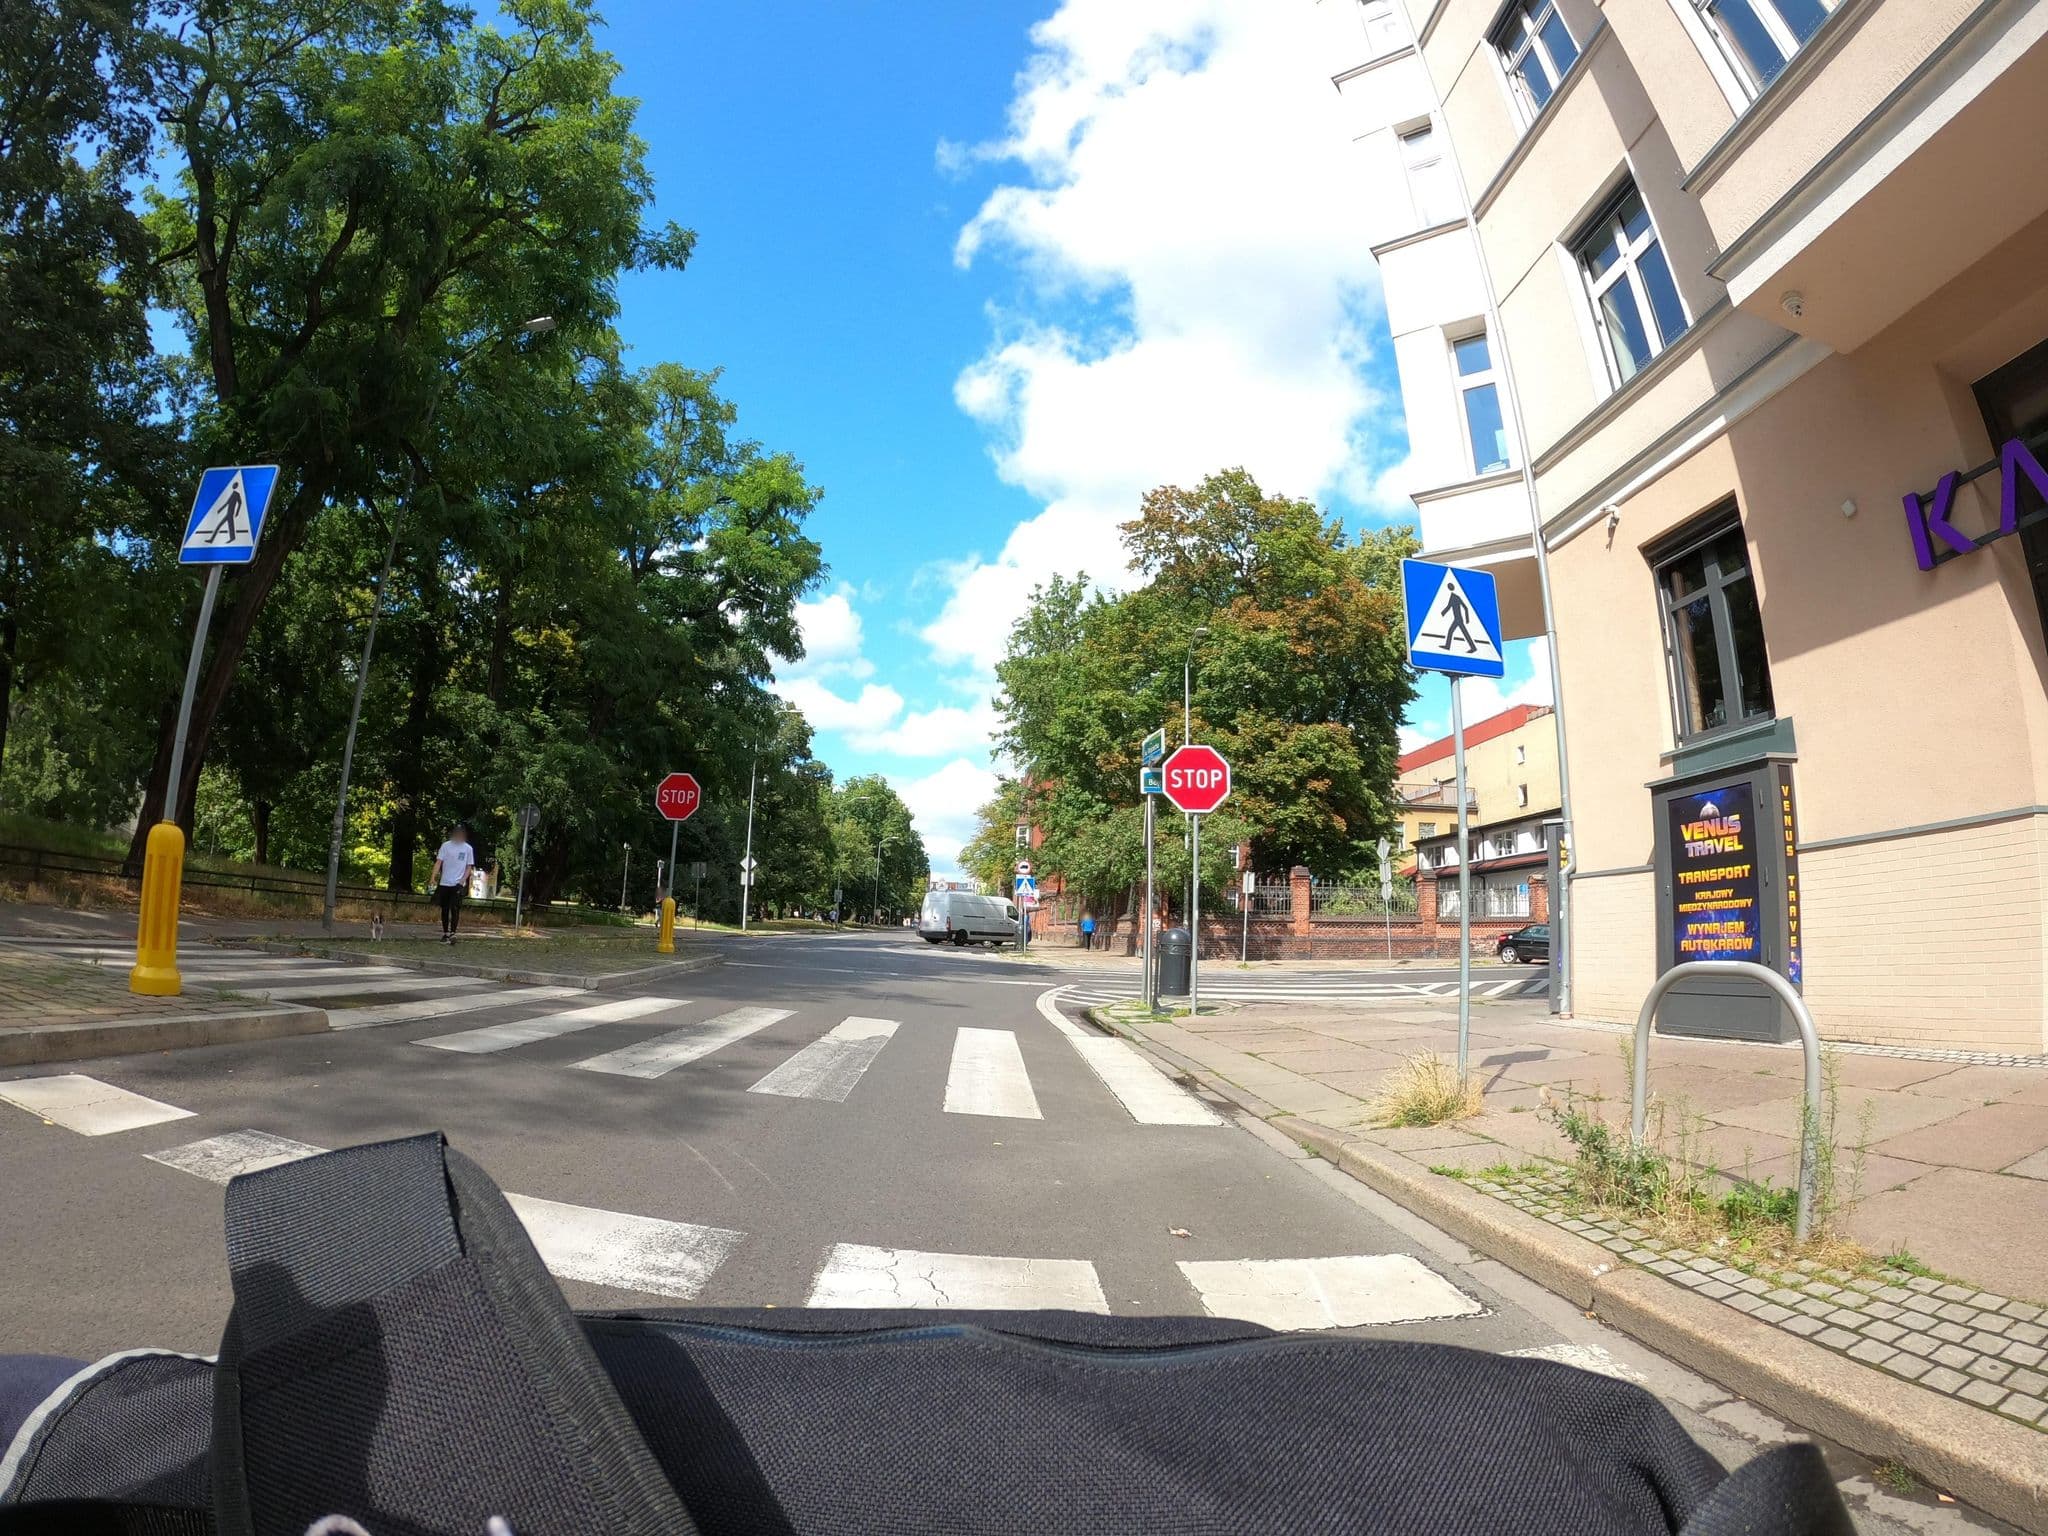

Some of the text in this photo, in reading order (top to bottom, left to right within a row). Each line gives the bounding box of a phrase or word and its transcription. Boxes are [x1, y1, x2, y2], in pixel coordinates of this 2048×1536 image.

[1170, 769, 1223, 790] STOP
[661, 789, 696, 805] STOP
[1680, 814, 1742, 842] VENUS
[1685, 835, 1744, 858] TRAVEL
[1678, 864, 1751, 885] TRANSPORT
[1781, 785, 1798, 962] VENUS TRAVEL
[1695, 888, 1734, 900] KRAJOWY
[1687, 921, 1745, 936] WYNAJEM
